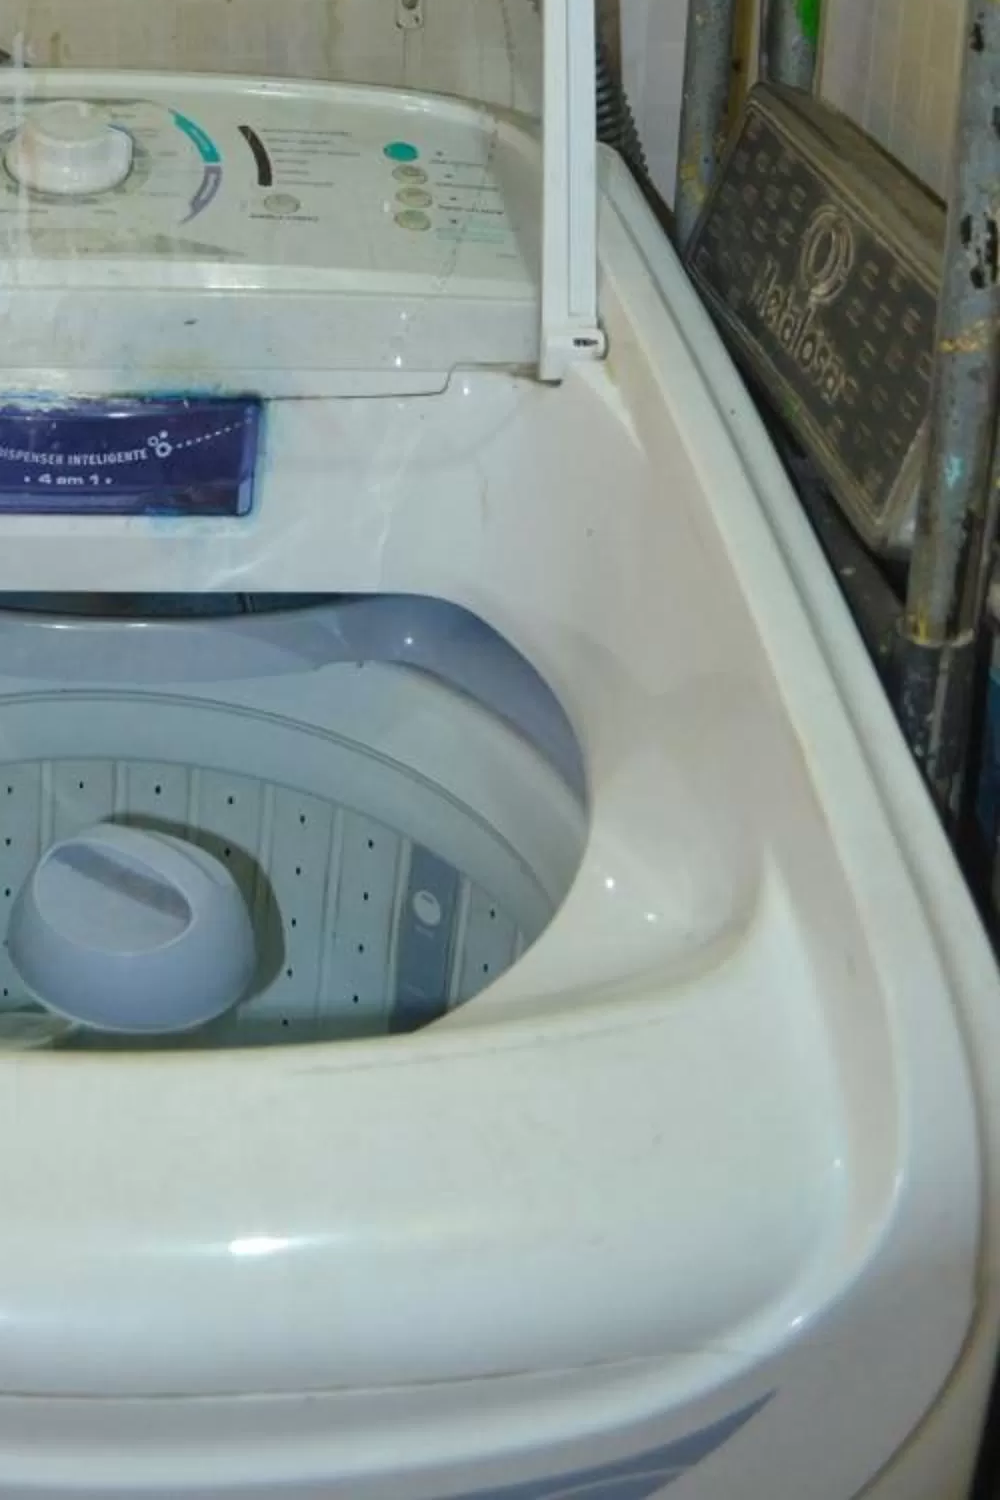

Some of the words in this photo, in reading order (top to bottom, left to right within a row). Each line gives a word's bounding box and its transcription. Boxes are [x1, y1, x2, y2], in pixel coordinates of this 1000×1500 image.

[67, 448, 148, 465] INTELIGENTE
[38, 473, 52, 485] 4
[56, 474, 84, 485] em
